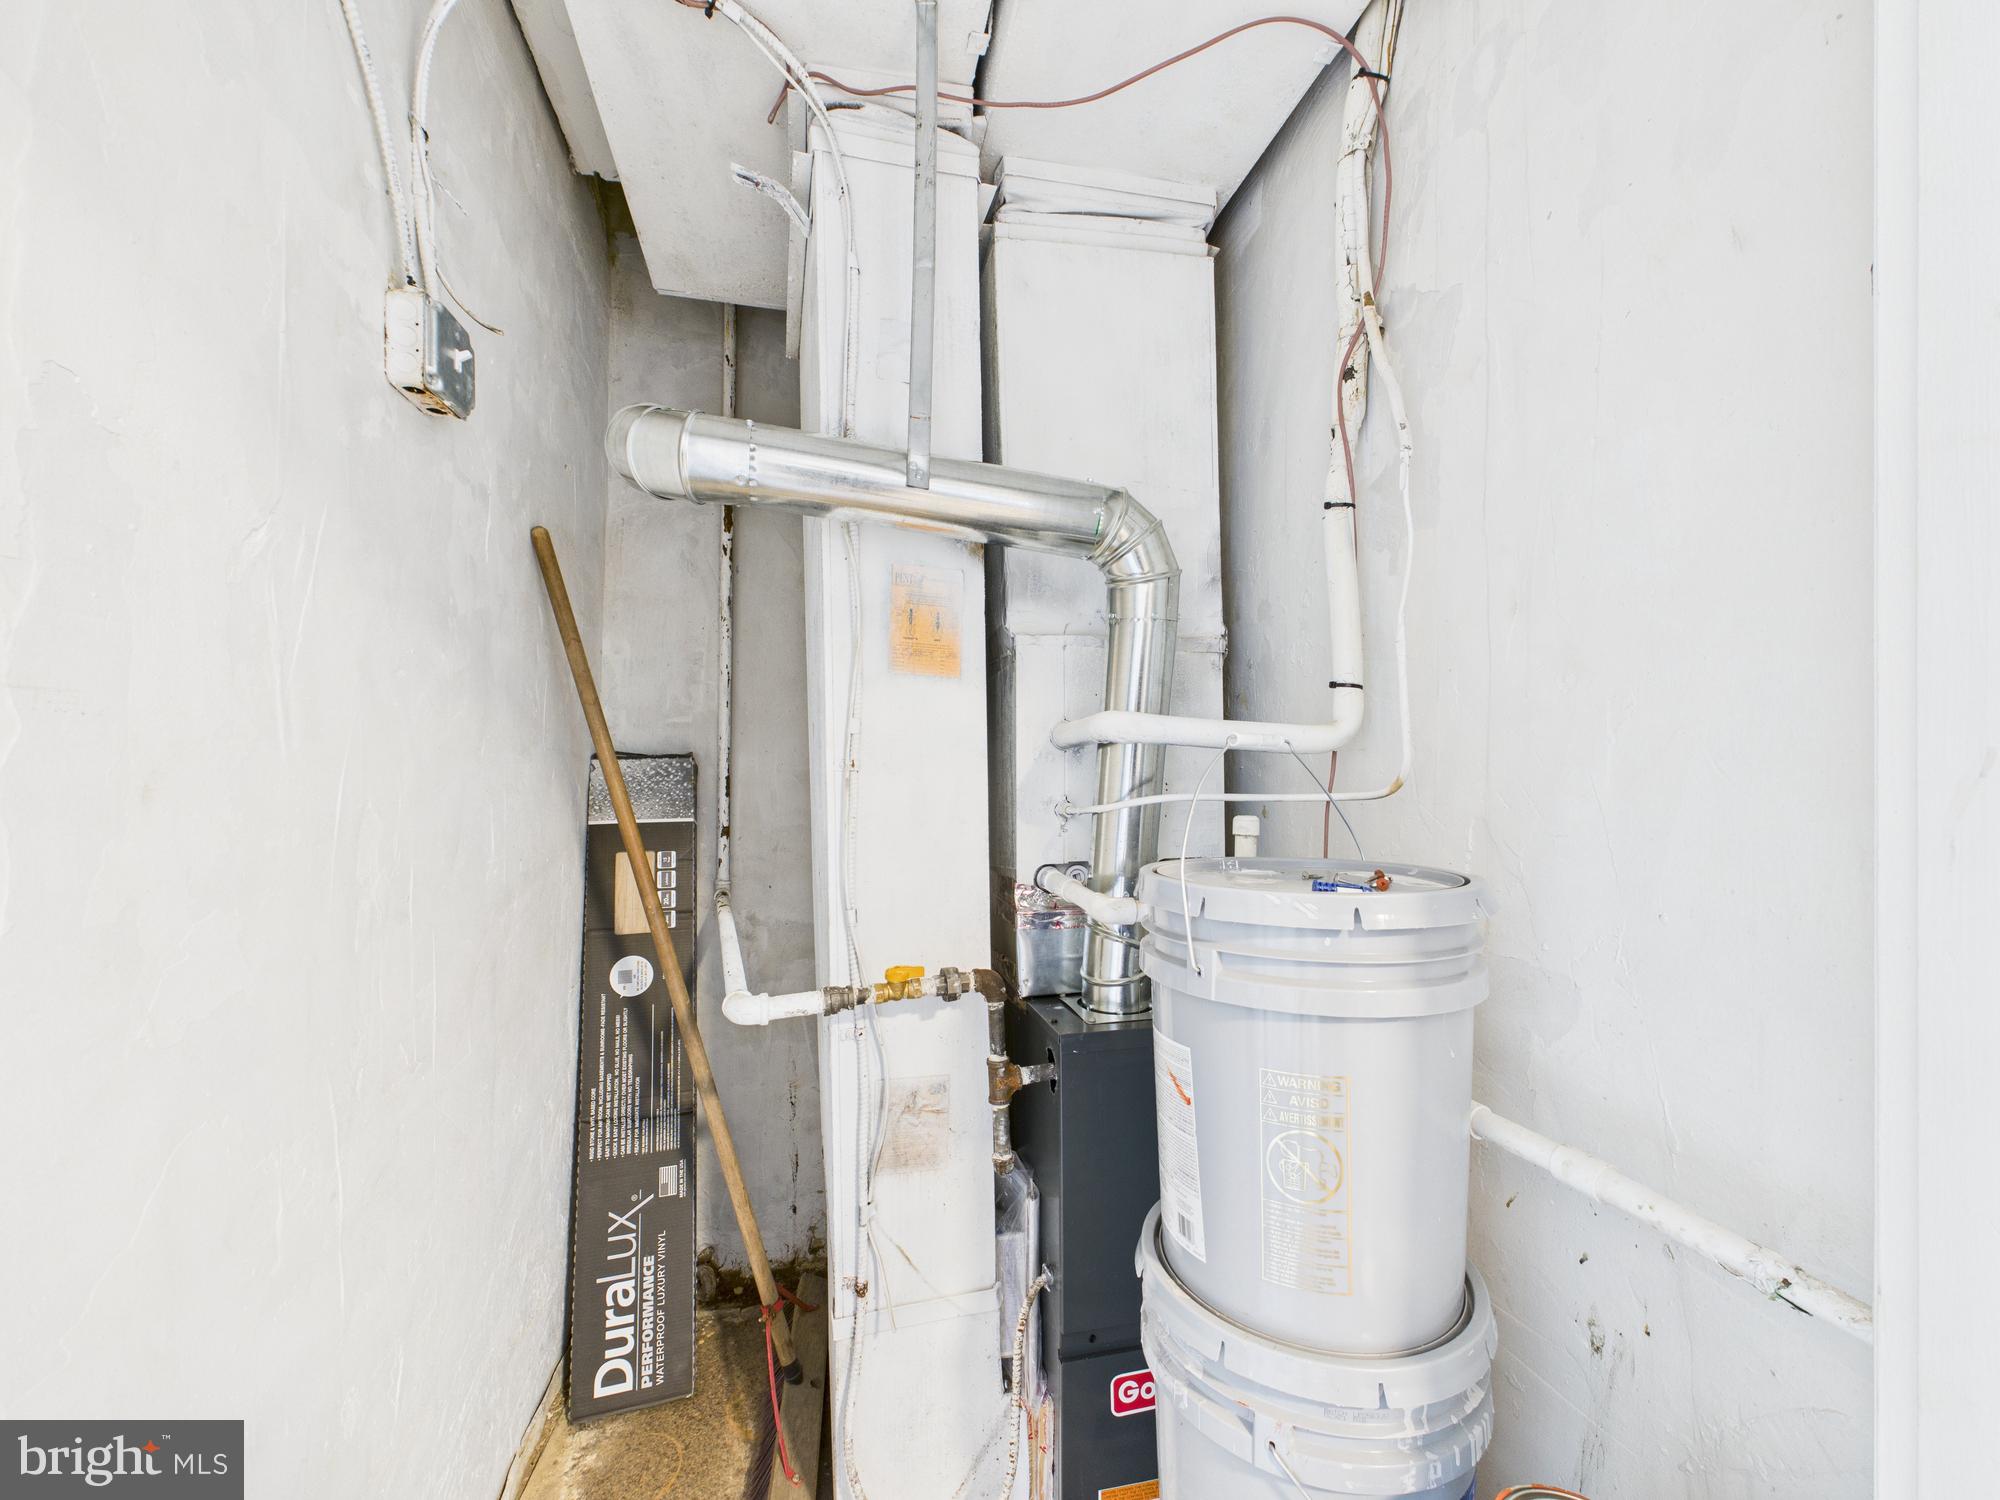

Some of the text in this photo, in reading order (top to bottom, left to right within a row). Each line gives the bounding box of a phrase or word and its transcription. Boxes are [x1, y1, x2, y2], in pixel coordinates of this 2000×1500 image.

[1277, 1074, 1342, 1093] WARNIG
[1279, 1111, 1344, 1129] AVERTISS
[1288, 1095, 1329, 1110] AVISO
[594, 1194, 654, 1398] DuraLux
[641, 1255, 655, 1389] PERFORMANCE
[656, 1230, 666, 1385] WATERPROOF LUXURY VINYL
